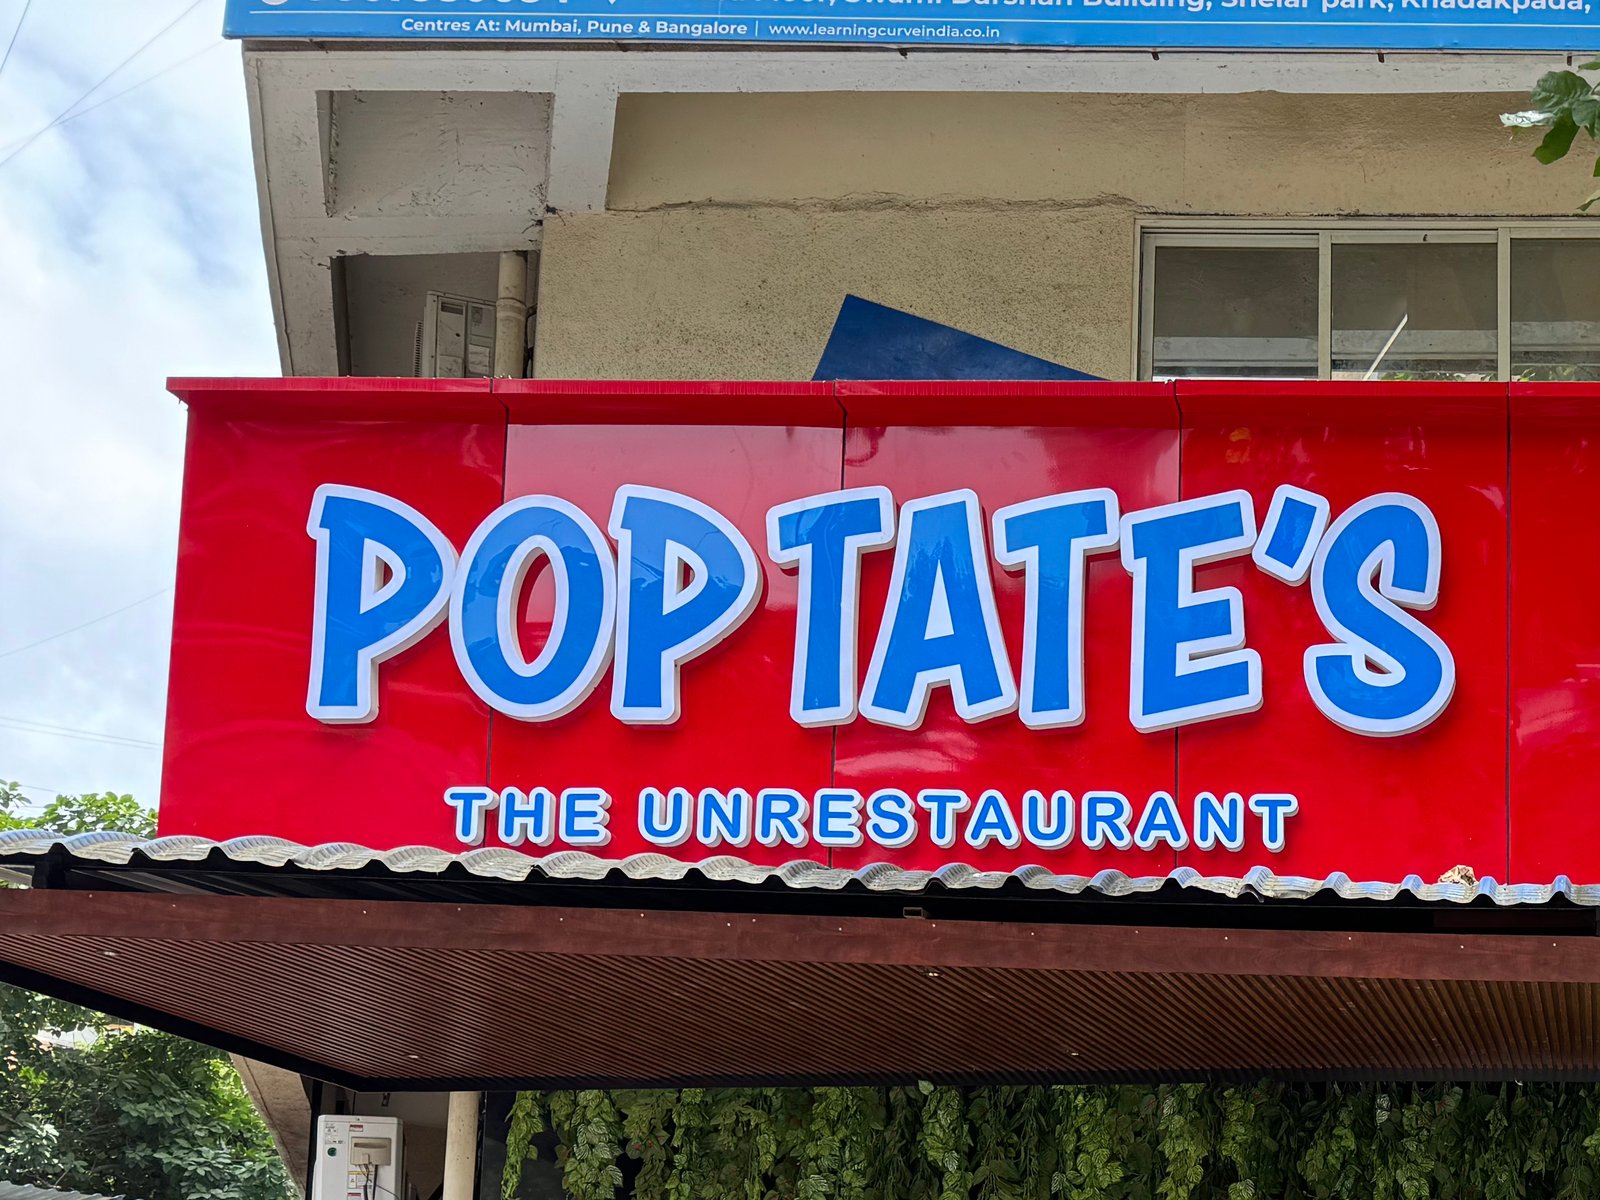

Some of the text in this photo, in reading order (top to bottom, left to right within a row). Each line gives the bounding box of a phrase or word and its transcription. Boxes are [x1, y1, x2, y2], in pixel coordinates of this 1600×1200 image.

[401, 18, 1000, 39] Centres At: Mumbai, Pune & Bangalore www.learningcurveindia.co.in
[444, 785, 1299, 854] THE UNRESTAURANT
